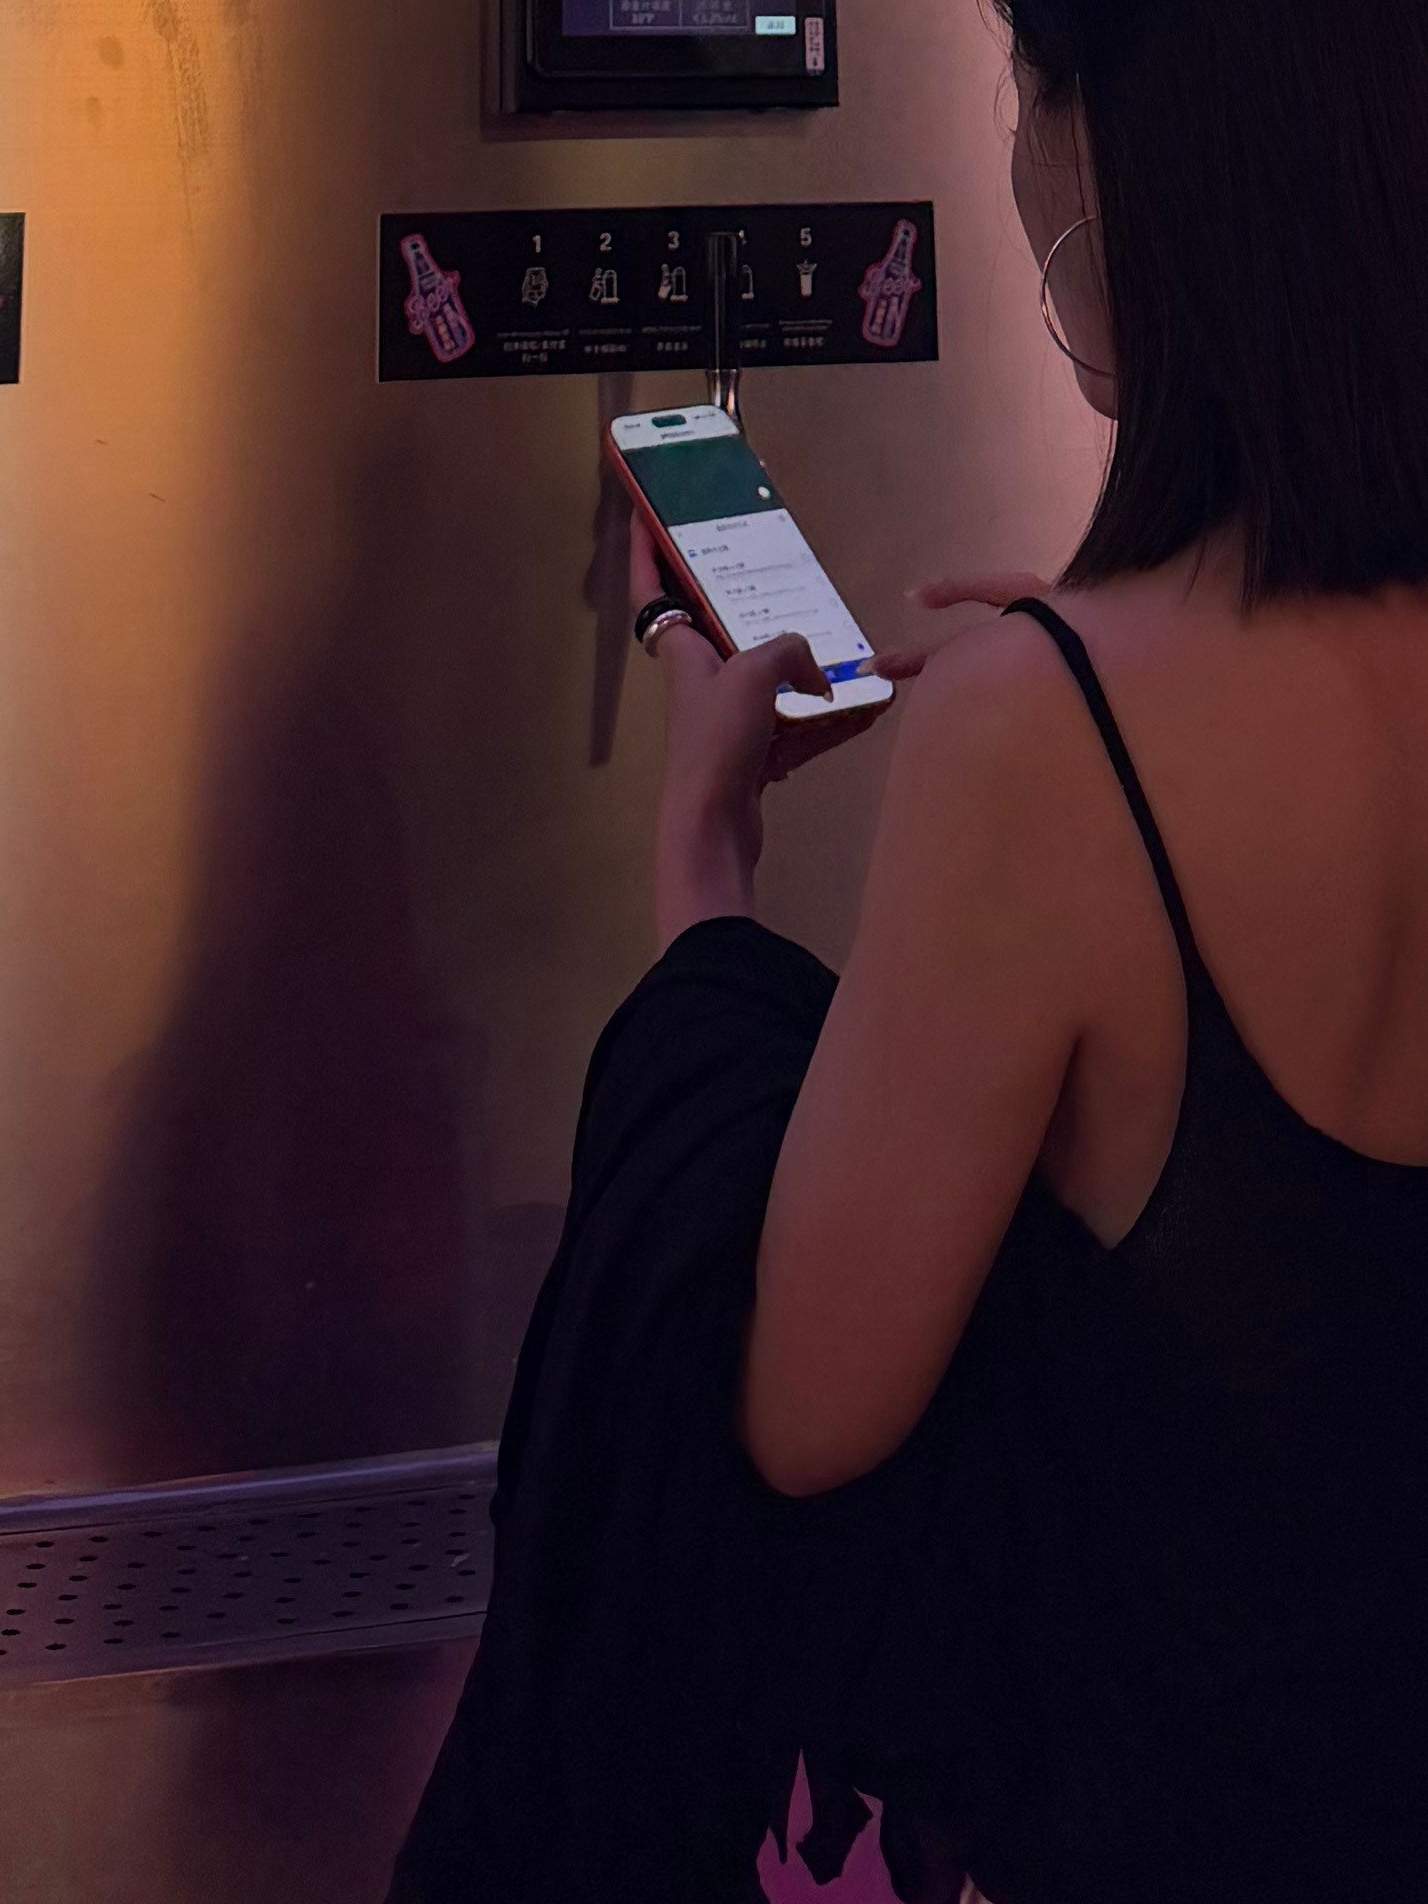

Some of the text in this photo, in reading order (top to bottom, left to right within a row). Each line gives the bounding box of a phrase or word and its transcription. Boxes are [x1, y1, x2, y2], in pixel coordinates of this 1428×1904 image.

[532, 228, 812, 253] 1 2 3 5
